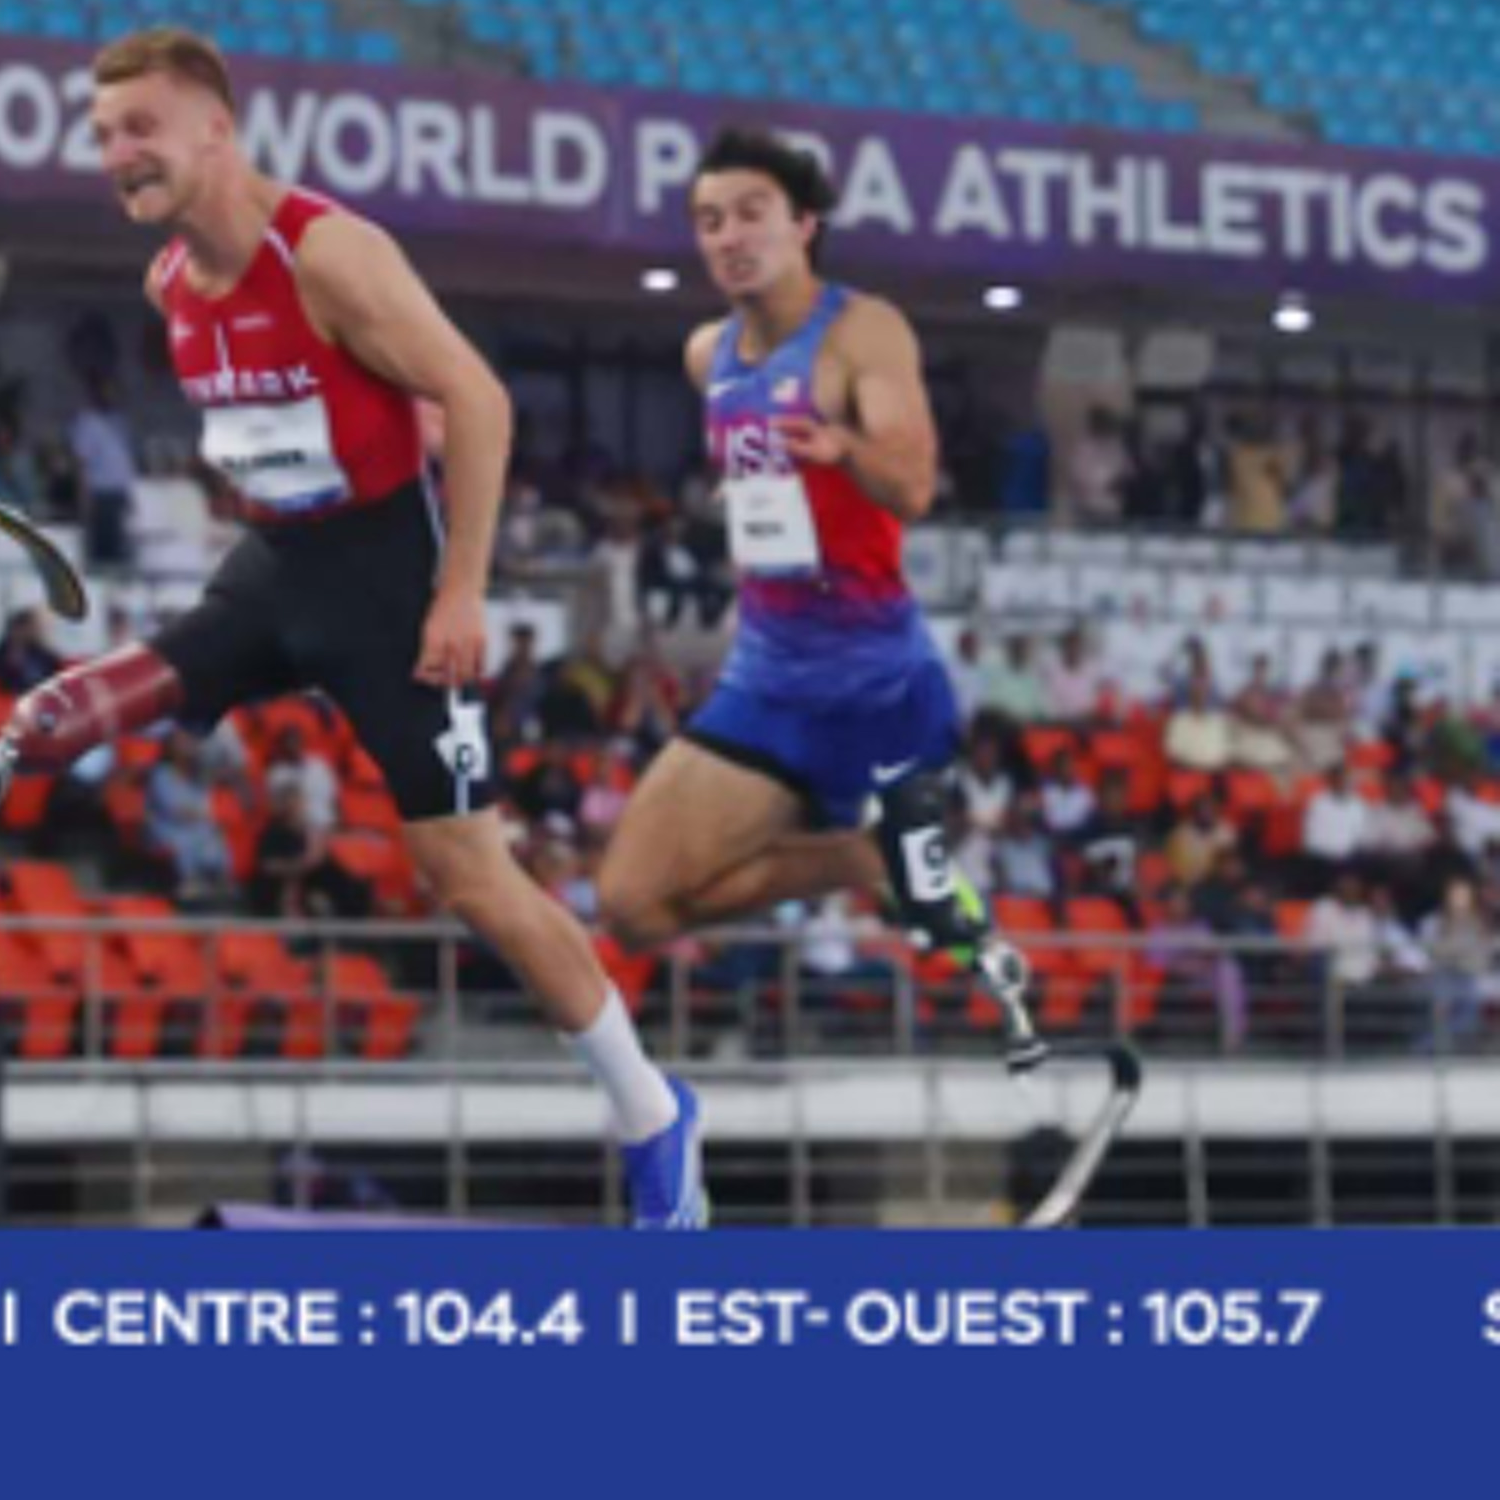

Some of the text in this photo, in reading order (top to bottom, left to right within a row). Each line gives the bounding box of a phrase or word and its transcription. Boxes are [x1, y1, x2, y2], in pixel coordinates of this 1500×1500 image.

[242, 91, 607, 206] WORLD
[636, 119, 914, 235] PA
[933, 143, 1488, 271] ATHLETICS
